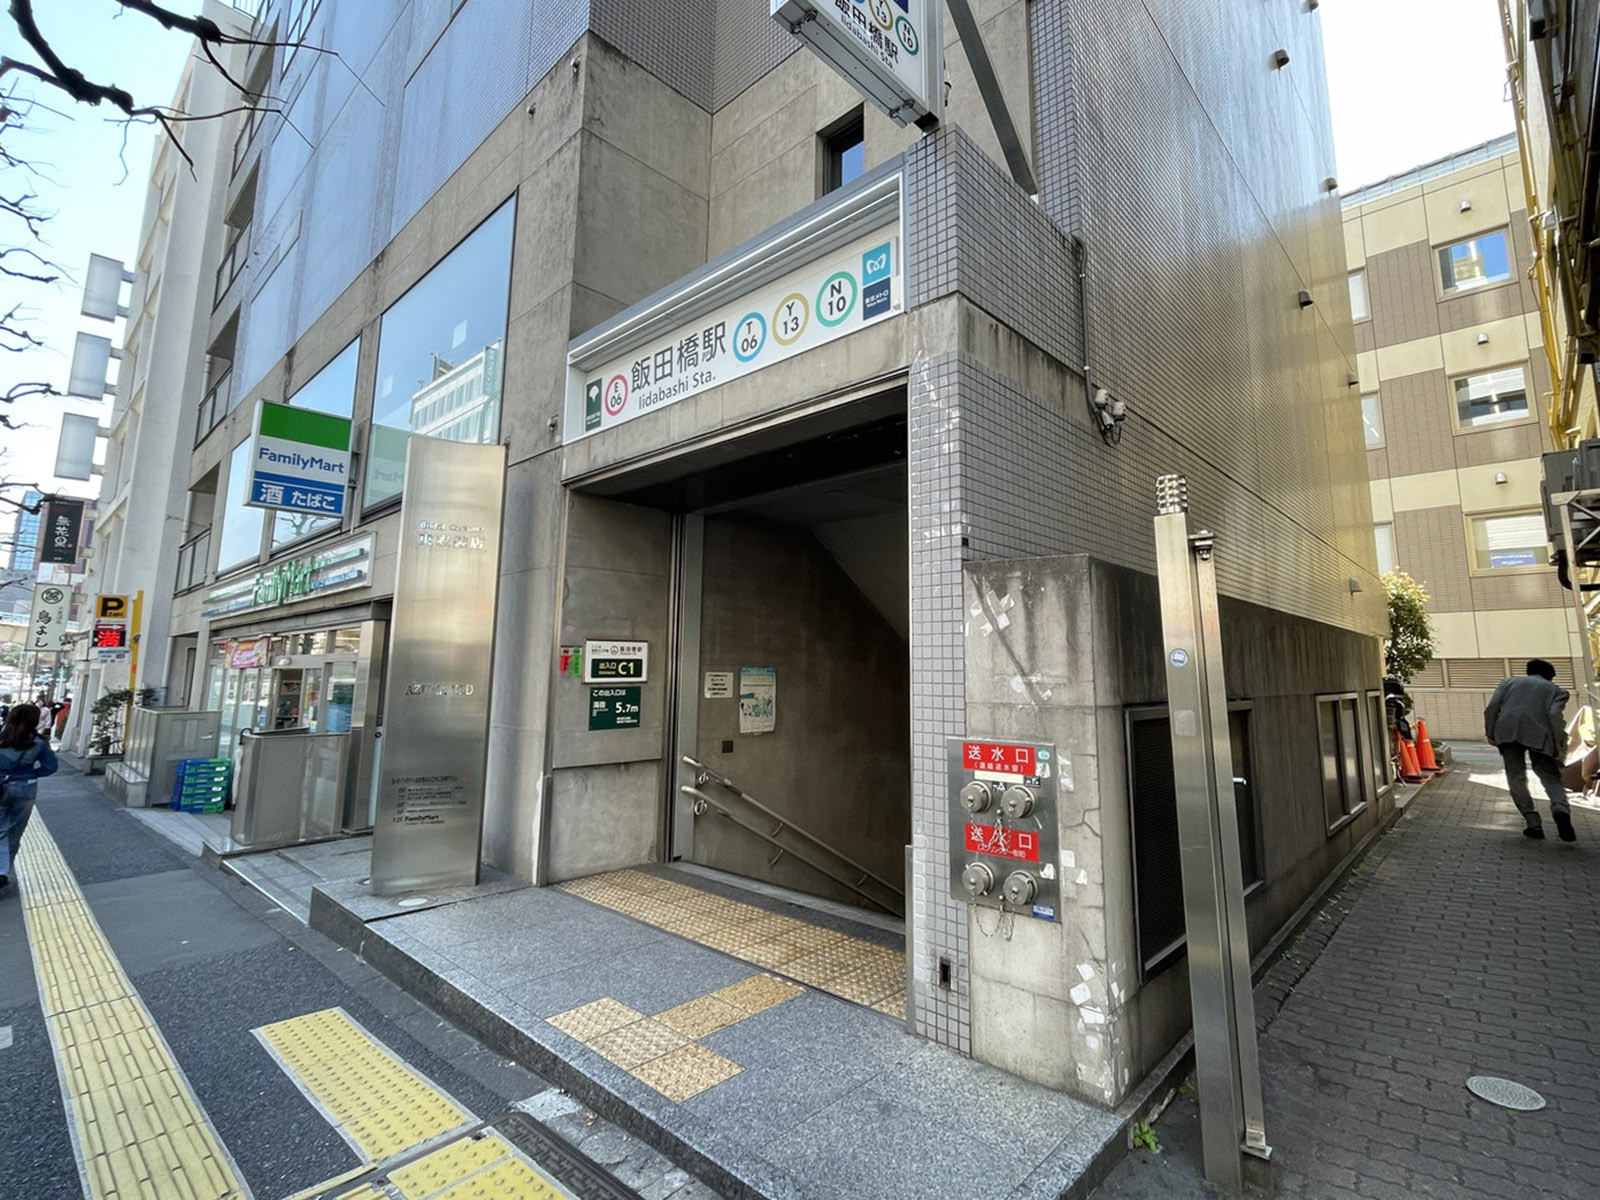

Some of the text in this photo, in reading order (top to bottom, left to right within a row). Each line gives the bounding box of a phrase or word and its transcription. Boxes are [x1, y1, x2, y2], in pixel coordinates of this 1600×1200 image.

[904, 23, 911, 36] N
[841, 14, 896, 72] Iidabashi Sta.
[903, 31, 914, 49] 10
[830, 280, 842, 298] N
[786, 302, 795, 316] Y
[828, 296, 846, 316] 10
[746, 321, 753, 334] T
[783, 316, 799, 335] 13
[741, 335, 758, 353] 06
[631, 321, 726, 393] 飯田橋駅
[614, 382, 619, 393] E
[638, 370, 716, 410] Iidabashi Sta.
[611, 394, 622, 407] 06
[259, 447, 344, 474] FamilyMart
[260, 483, 335, 510] 酒 たばこ
[101, 597, 124, 617] P
[618, 662, 634, 675] C1
[615, 702, 639, 713] 5.7m
[968, 745, 1029, 763] 送水口
